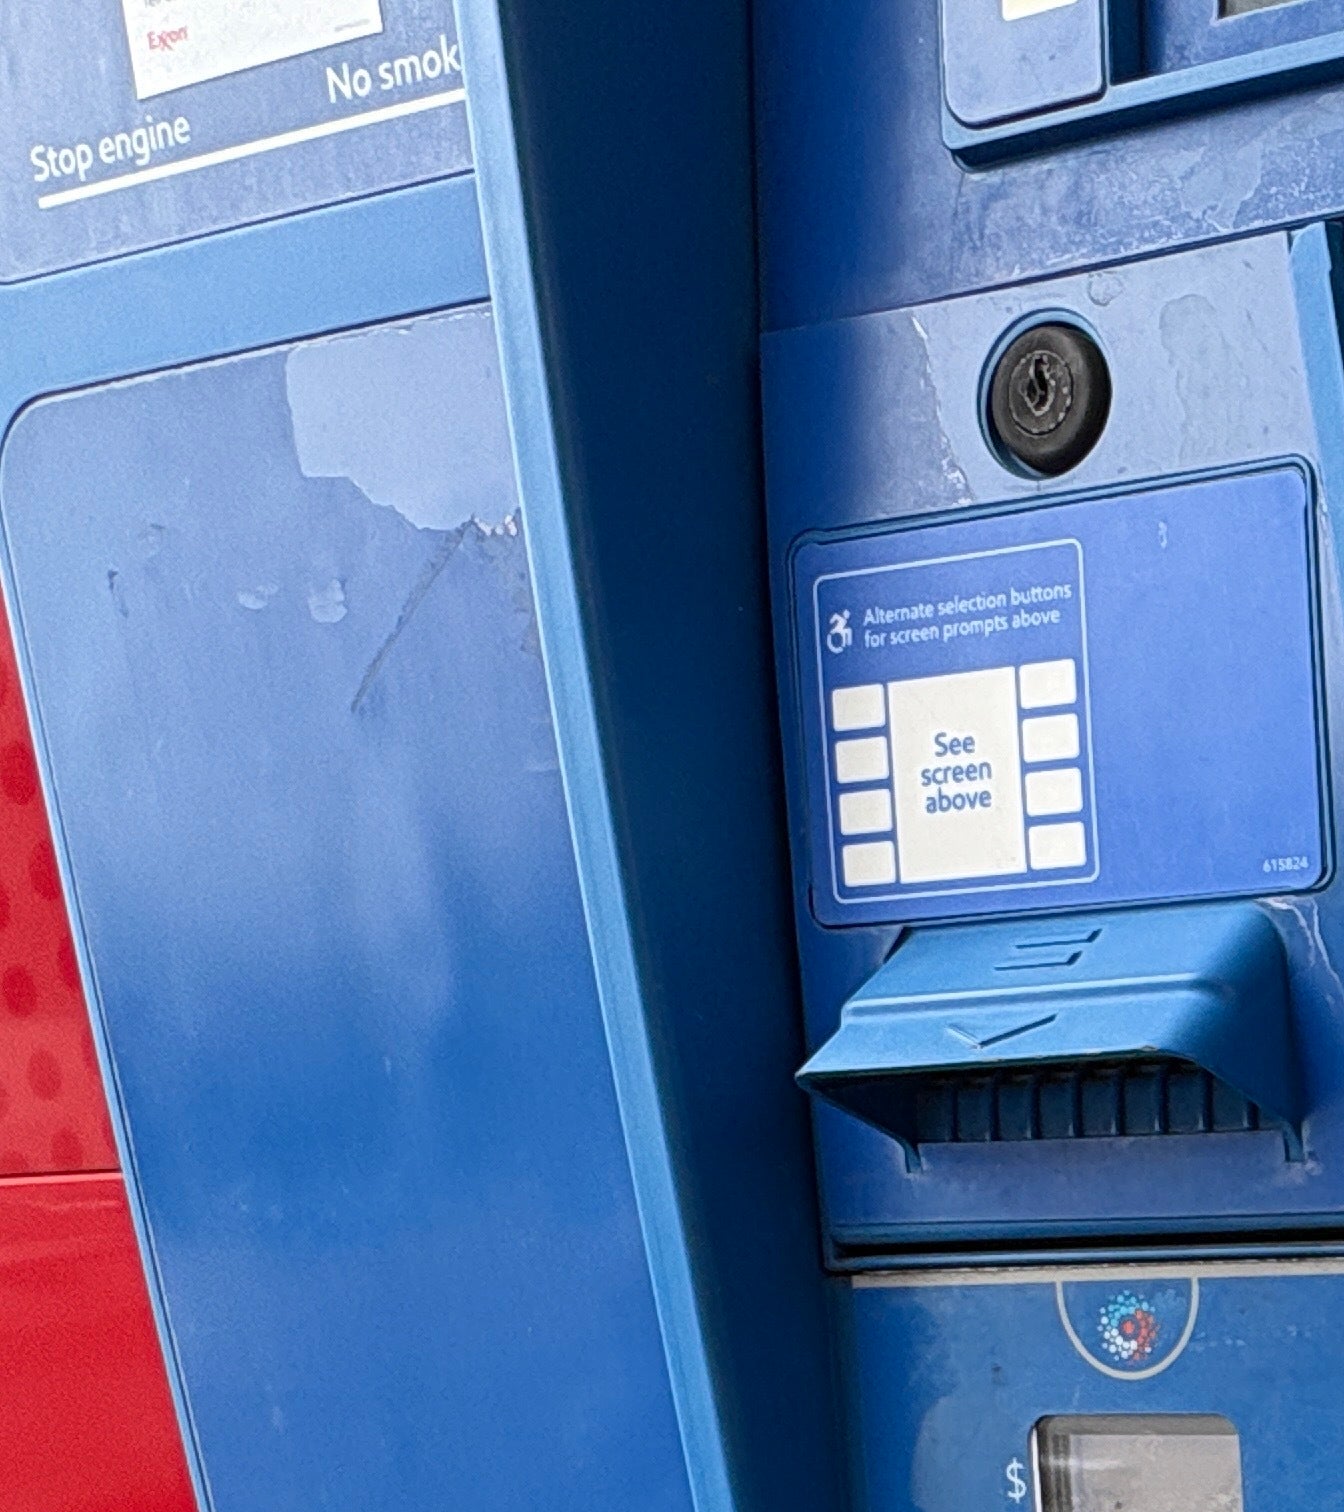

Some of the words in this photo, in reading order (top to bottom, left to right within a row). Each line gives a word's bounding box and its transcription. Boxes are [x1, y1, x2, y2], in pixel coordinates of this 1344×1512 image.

[326, 62, 371, 103] No
[30, 142, 93, 182] Stop
[100, 116, 191, 166] engine
[863, 603, 934, 626] Alternate
[938, 591, 1006, 615] selection
[1010, 584, 1072, 607] buttons
[865, 629, 885, 648] for
[890, 626, 939, 646] screen
[943, 616, 1008, 643] prompts
[1012, 609, 1060, 629] above
[934, 731, 975, 758] See
[920, 759, 992, 787] screen
[925, 788, 992, 814] above
[1006, 1457, 1027, 1503] $
